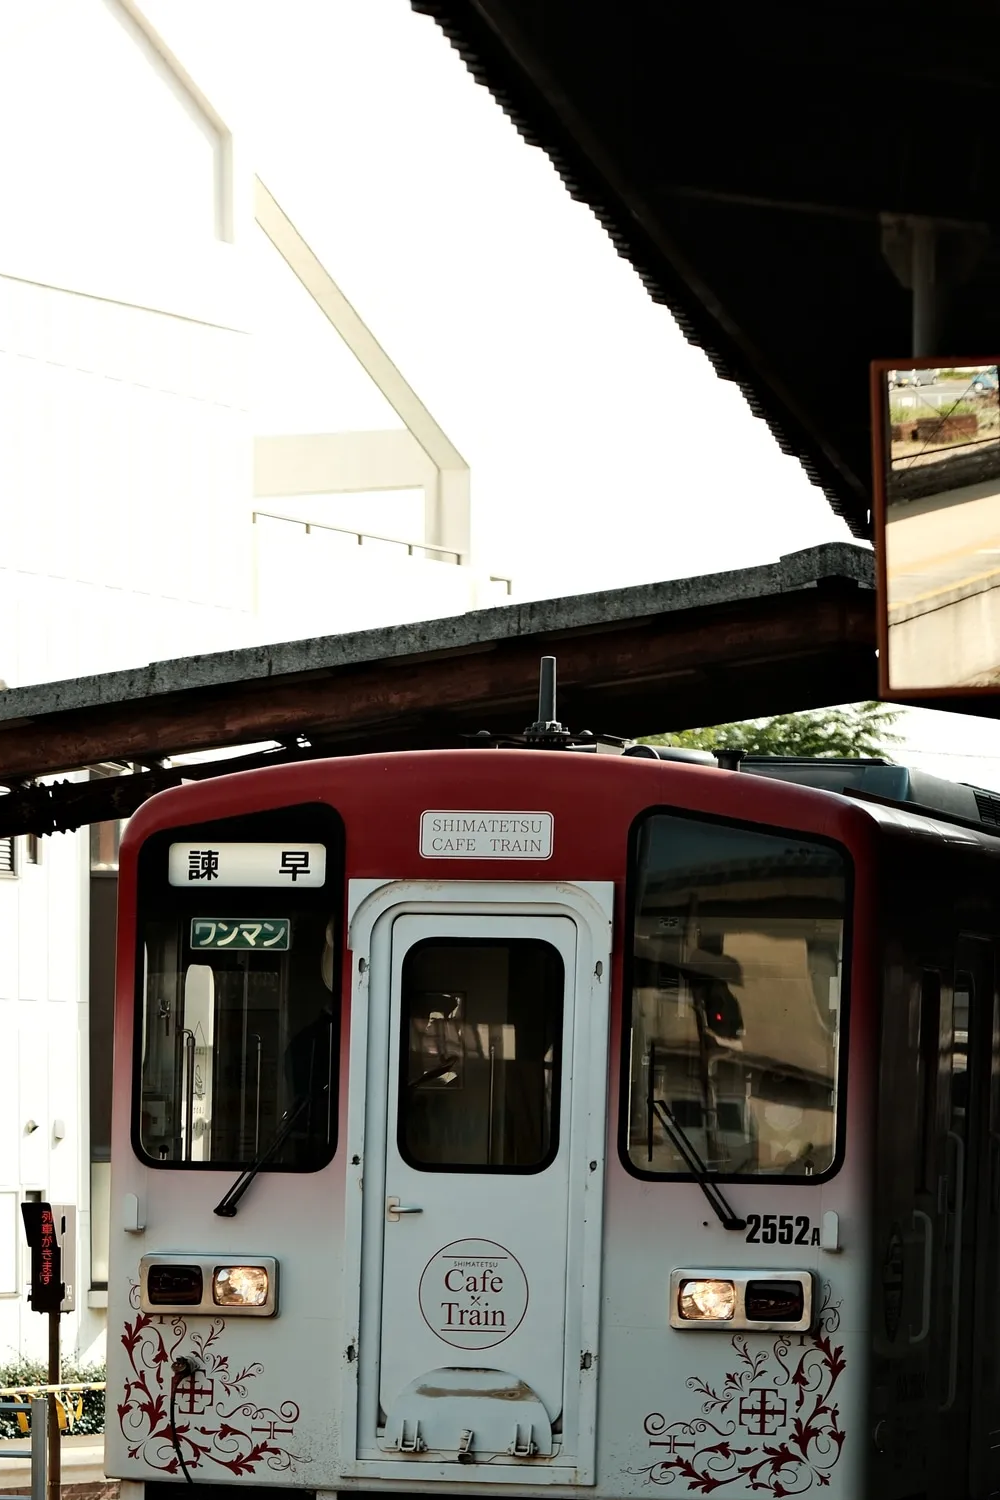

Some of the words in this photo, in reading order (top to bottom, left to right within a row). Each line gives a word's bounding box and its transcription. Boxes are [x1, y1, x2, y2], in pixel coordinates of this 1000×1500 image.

[432, 818, 543, 833] SHIMATETSU
[432, 838, 476, 851] CAFE
[490, 839, 542, 852] TRAIN
[188, 850, 311, 881] 諫早
[195, 922, 286, 946] ワンマン
[745, 1214, 820, 1246] 2552A
[41, 1210, 54, 1286] 列車がきます
[444, 1269, 503, 1293] Cafe
[441, 1302, 507, 1326] Train
